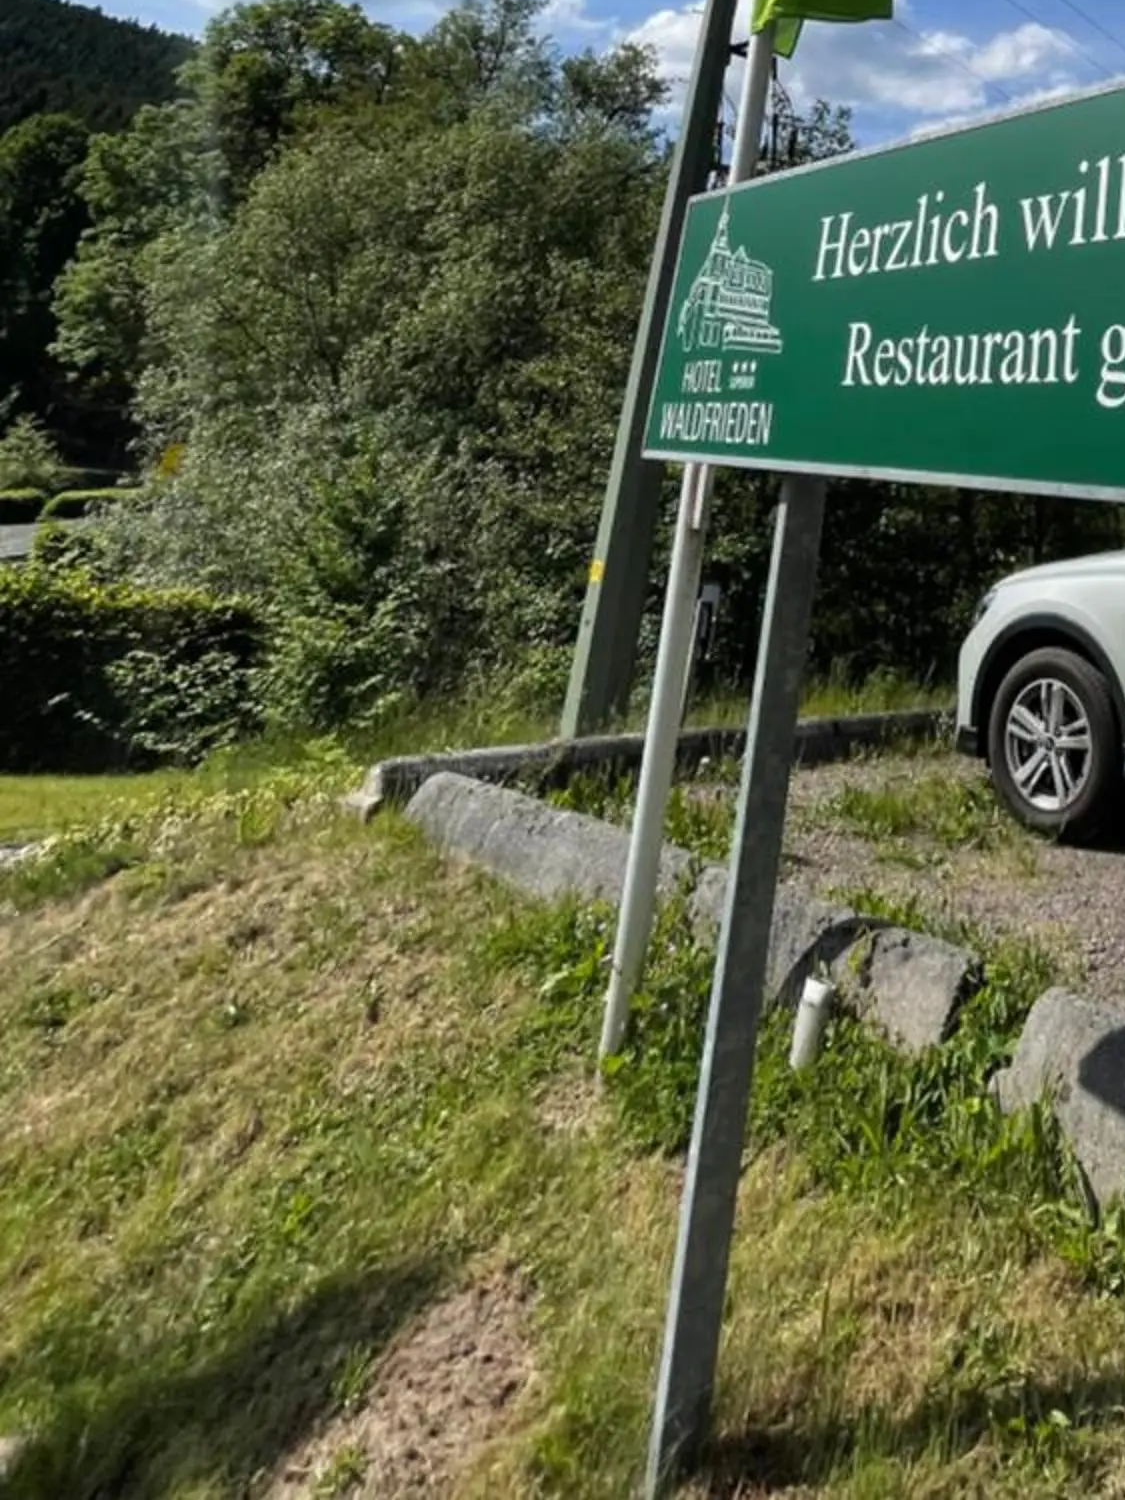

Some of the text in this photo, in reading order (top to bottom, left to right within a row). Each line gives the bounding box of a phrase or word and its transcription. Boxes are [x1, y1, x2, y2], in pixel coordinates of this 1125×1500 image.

[812, 181, 999, 281] Herzlich
[682, 359, 722, 393] HOTEL
[841, 314, 1081, 386] Restaurant
[660, 401, 773, 445] WALDFRIEDEN
